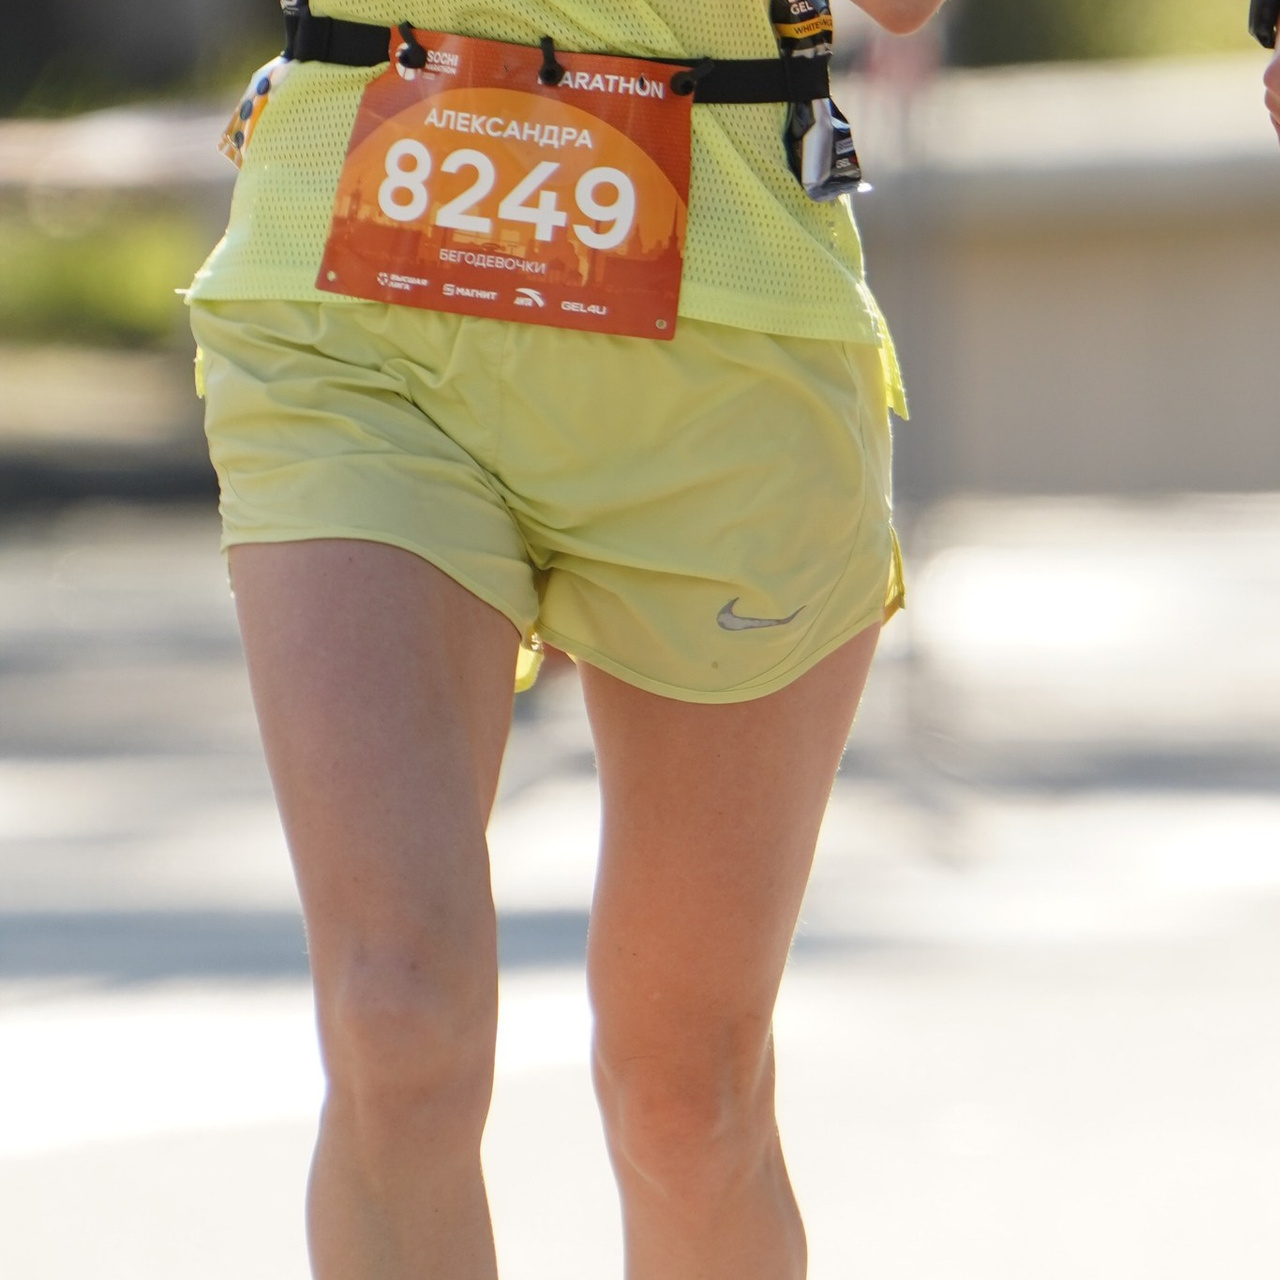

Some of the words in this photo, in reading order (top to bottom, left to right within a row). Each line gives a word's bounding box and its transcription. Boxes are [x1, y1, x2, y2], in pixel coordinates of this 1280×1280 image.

[790, 1, 813, 15] GEL
[426, 50, 459, 67] SOCHI
[537, 70, 665, 100] ARATHON
[424, 108, 593, 151] АЛЕКСАНДРА
[377, 138, 636, 251] 8249
[439, 248, 546, 276] БЕГОДЕВОЧКИ
[455, 286, 498, 301] МАГНИТ
[561, 300, 607, 316] GEL4U
